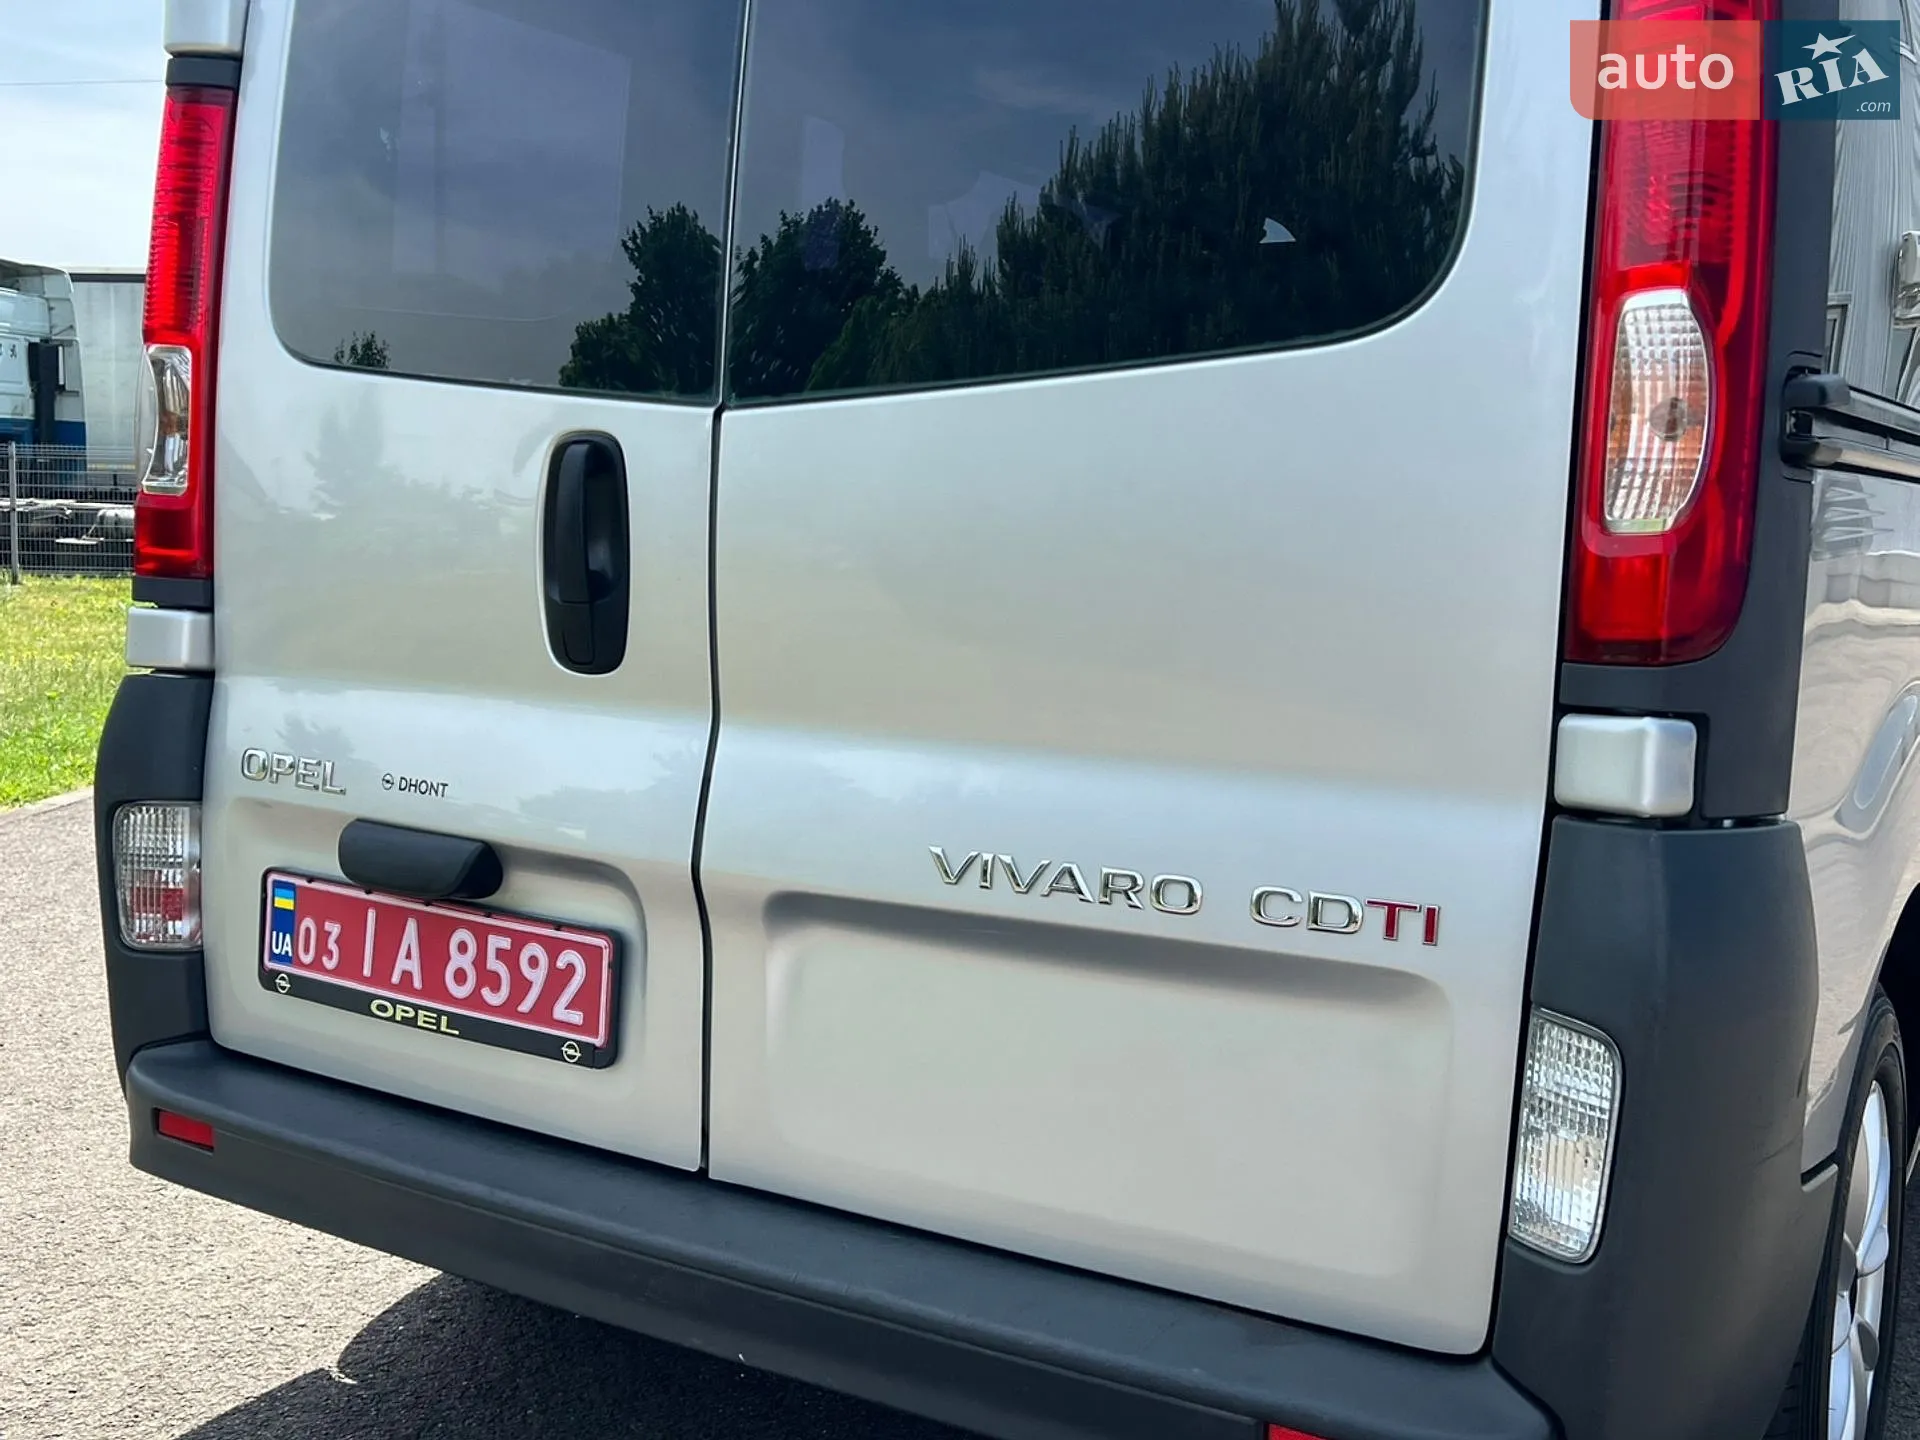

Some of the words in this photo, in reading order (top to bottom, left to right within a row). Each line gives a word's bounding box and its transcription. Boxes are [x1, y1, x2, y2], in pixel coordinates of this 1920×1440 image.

[241, 747, 347, 796] OPEL
[398, 776, 449, 798] DHONT
[928, 845, 1203, 915] VIVARO
[1249, 884, 1442, 947] CDTI
[272, 930, 293, 958] UA
[297, 916, 343, 971] 03
[443, 926, 587, 1027] 8592
[370, 999, 460, 1036] OPEL
